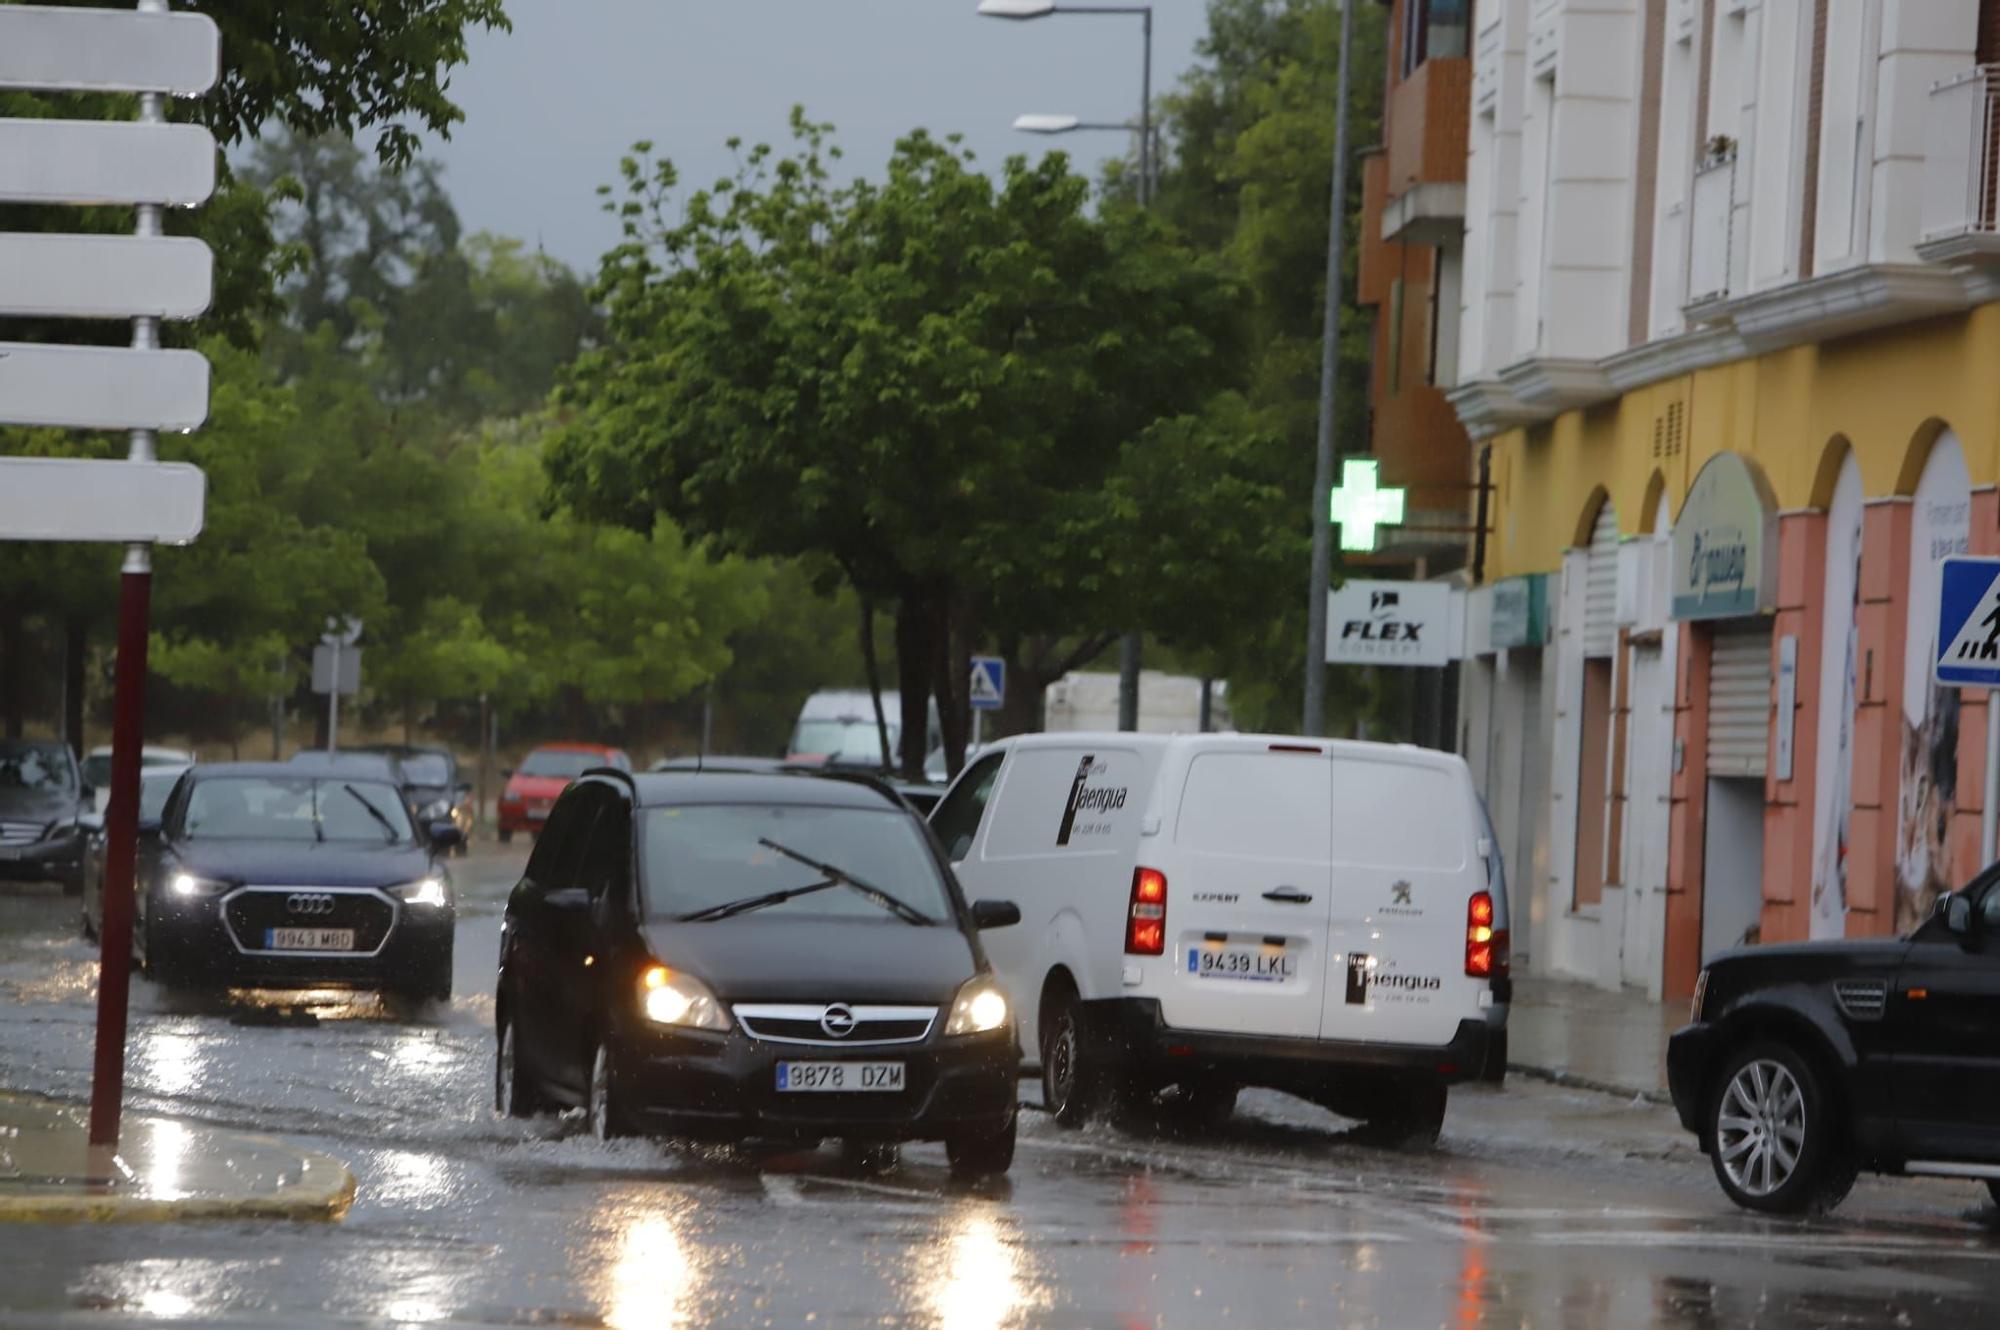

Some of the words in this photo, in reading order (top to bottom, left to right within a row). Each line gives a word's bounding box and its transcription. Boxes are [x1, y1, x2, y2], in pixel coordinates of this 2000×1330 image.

[1341, 621, 1425, 642] FLEX
[1338, 641, 1423, 656] CONCEPT
[1071, 779, 1128, 815] Taengua
[1192, 893, 1239, 904] EXPERT
[276, 930, 315, 946] 9943
[1202, 951, 1251, 973] 9439
[1256, 955, 1292, 976] LKL
[789, 1065, 845, 1088] 9878
[861, 1066, 901, 1088] DZM
